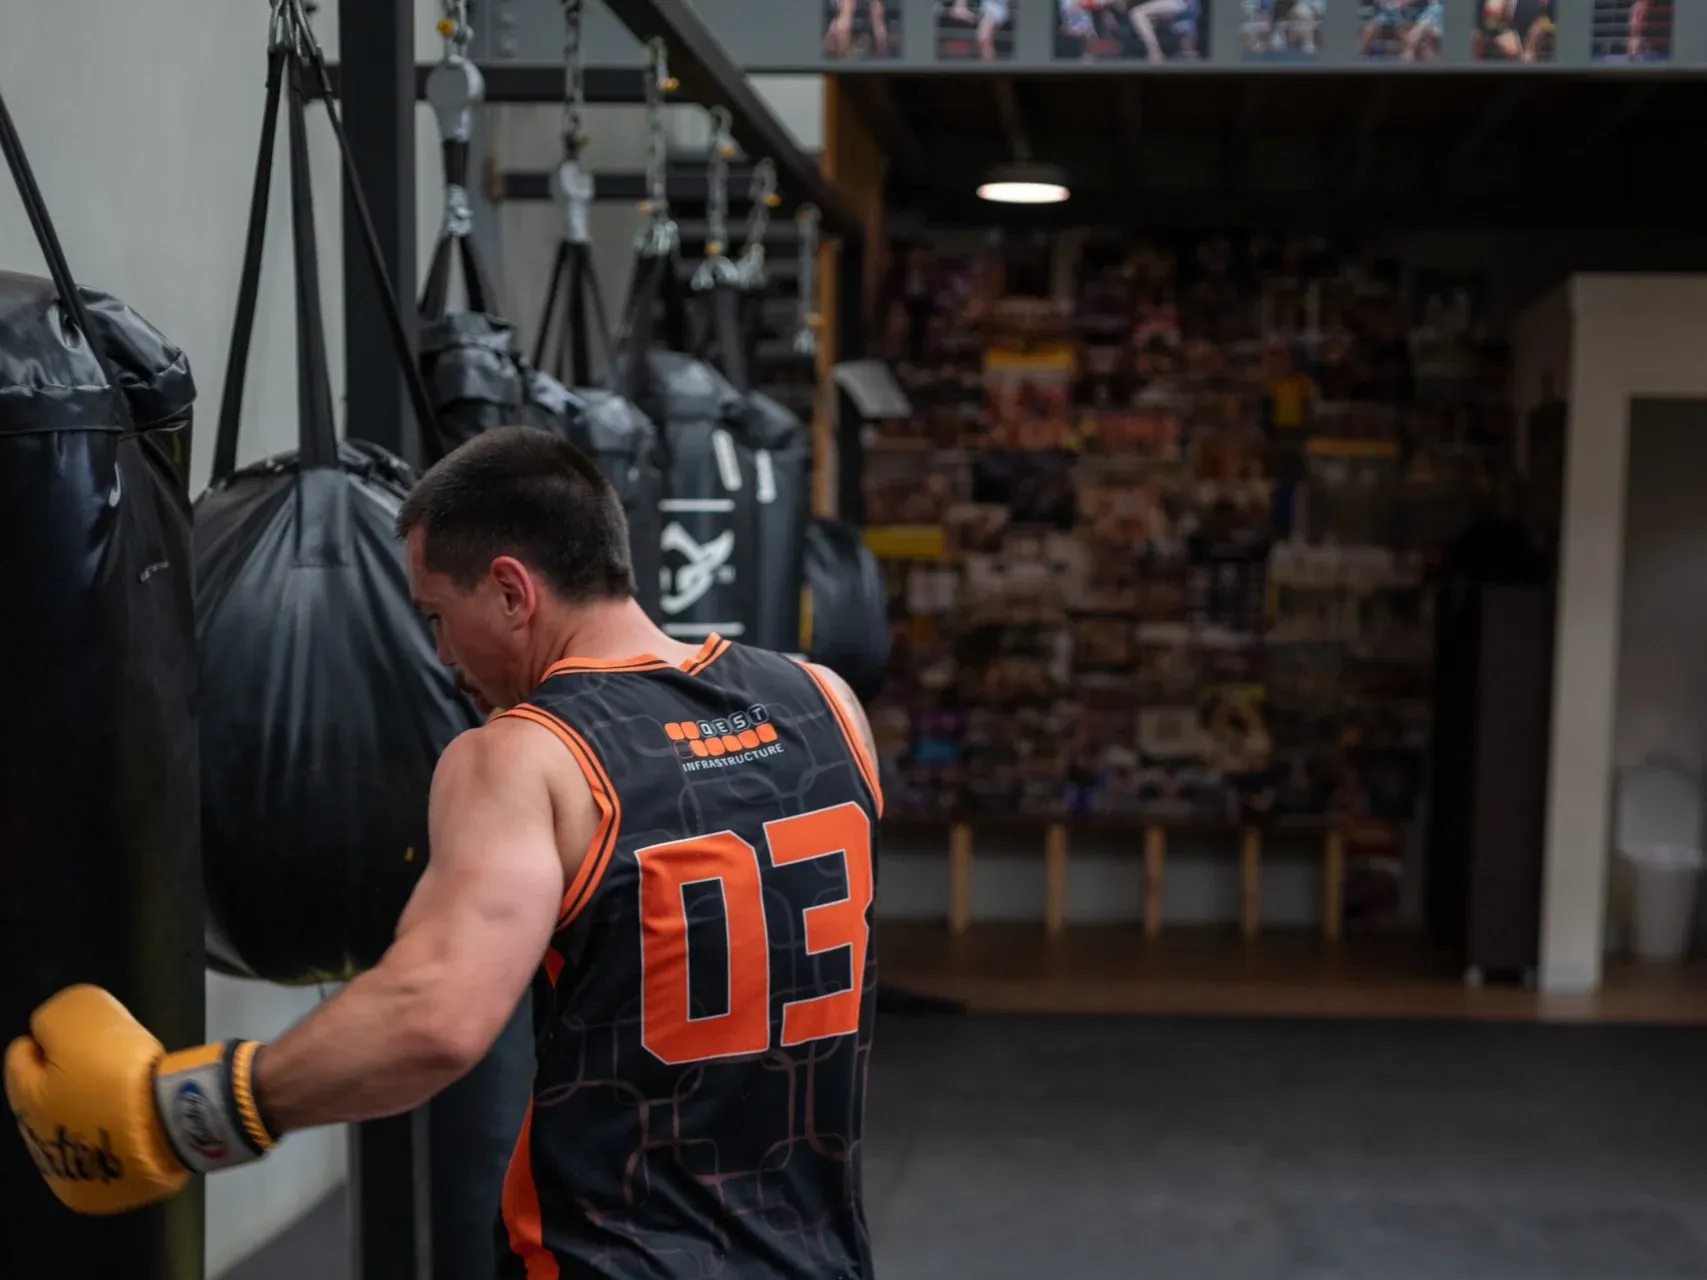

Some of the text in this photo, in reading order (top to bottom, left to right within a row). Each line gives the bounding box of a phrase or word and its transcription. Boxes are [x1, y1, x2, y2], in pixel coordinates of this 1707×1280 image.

[698, 706, 765, 736] QEST
[682, 743, 784, 772] INFRASTRUCTURE
[634, 801, 873, 1065] 03
